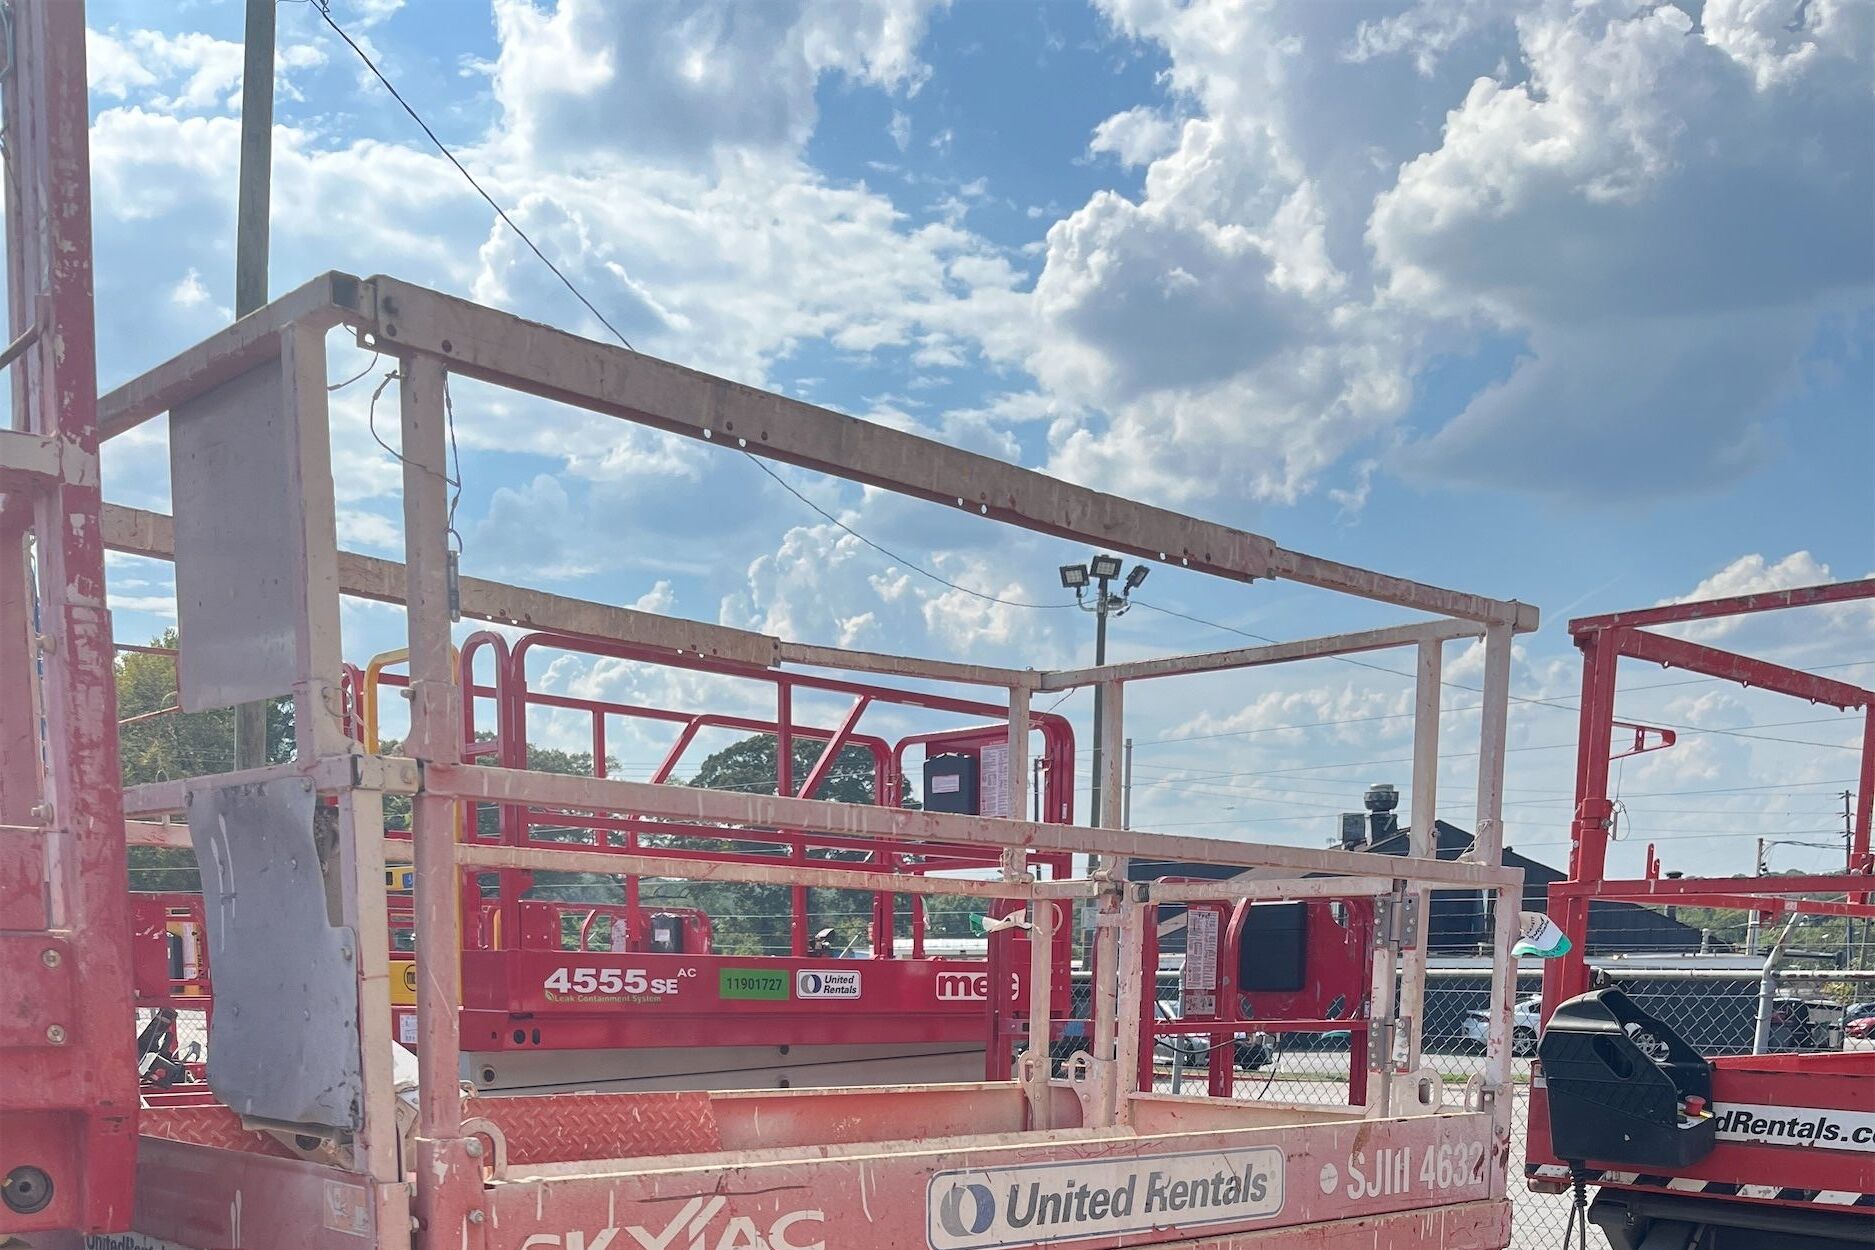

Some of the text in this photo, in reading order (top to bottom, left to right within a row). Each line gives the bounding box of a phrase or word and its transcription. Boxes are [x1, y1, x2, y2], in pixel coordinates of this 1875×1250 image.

[544, 967, 697, 994] 4555 SE AC
[727, 977, 783, 991] 11901727
[823, 984, 857, 994] Rentals
[824, 974, 855, 984] United
[1419, 1140, 1485, 1190] 4632
[1006, 1163, 1268, 1229] United Rentals
